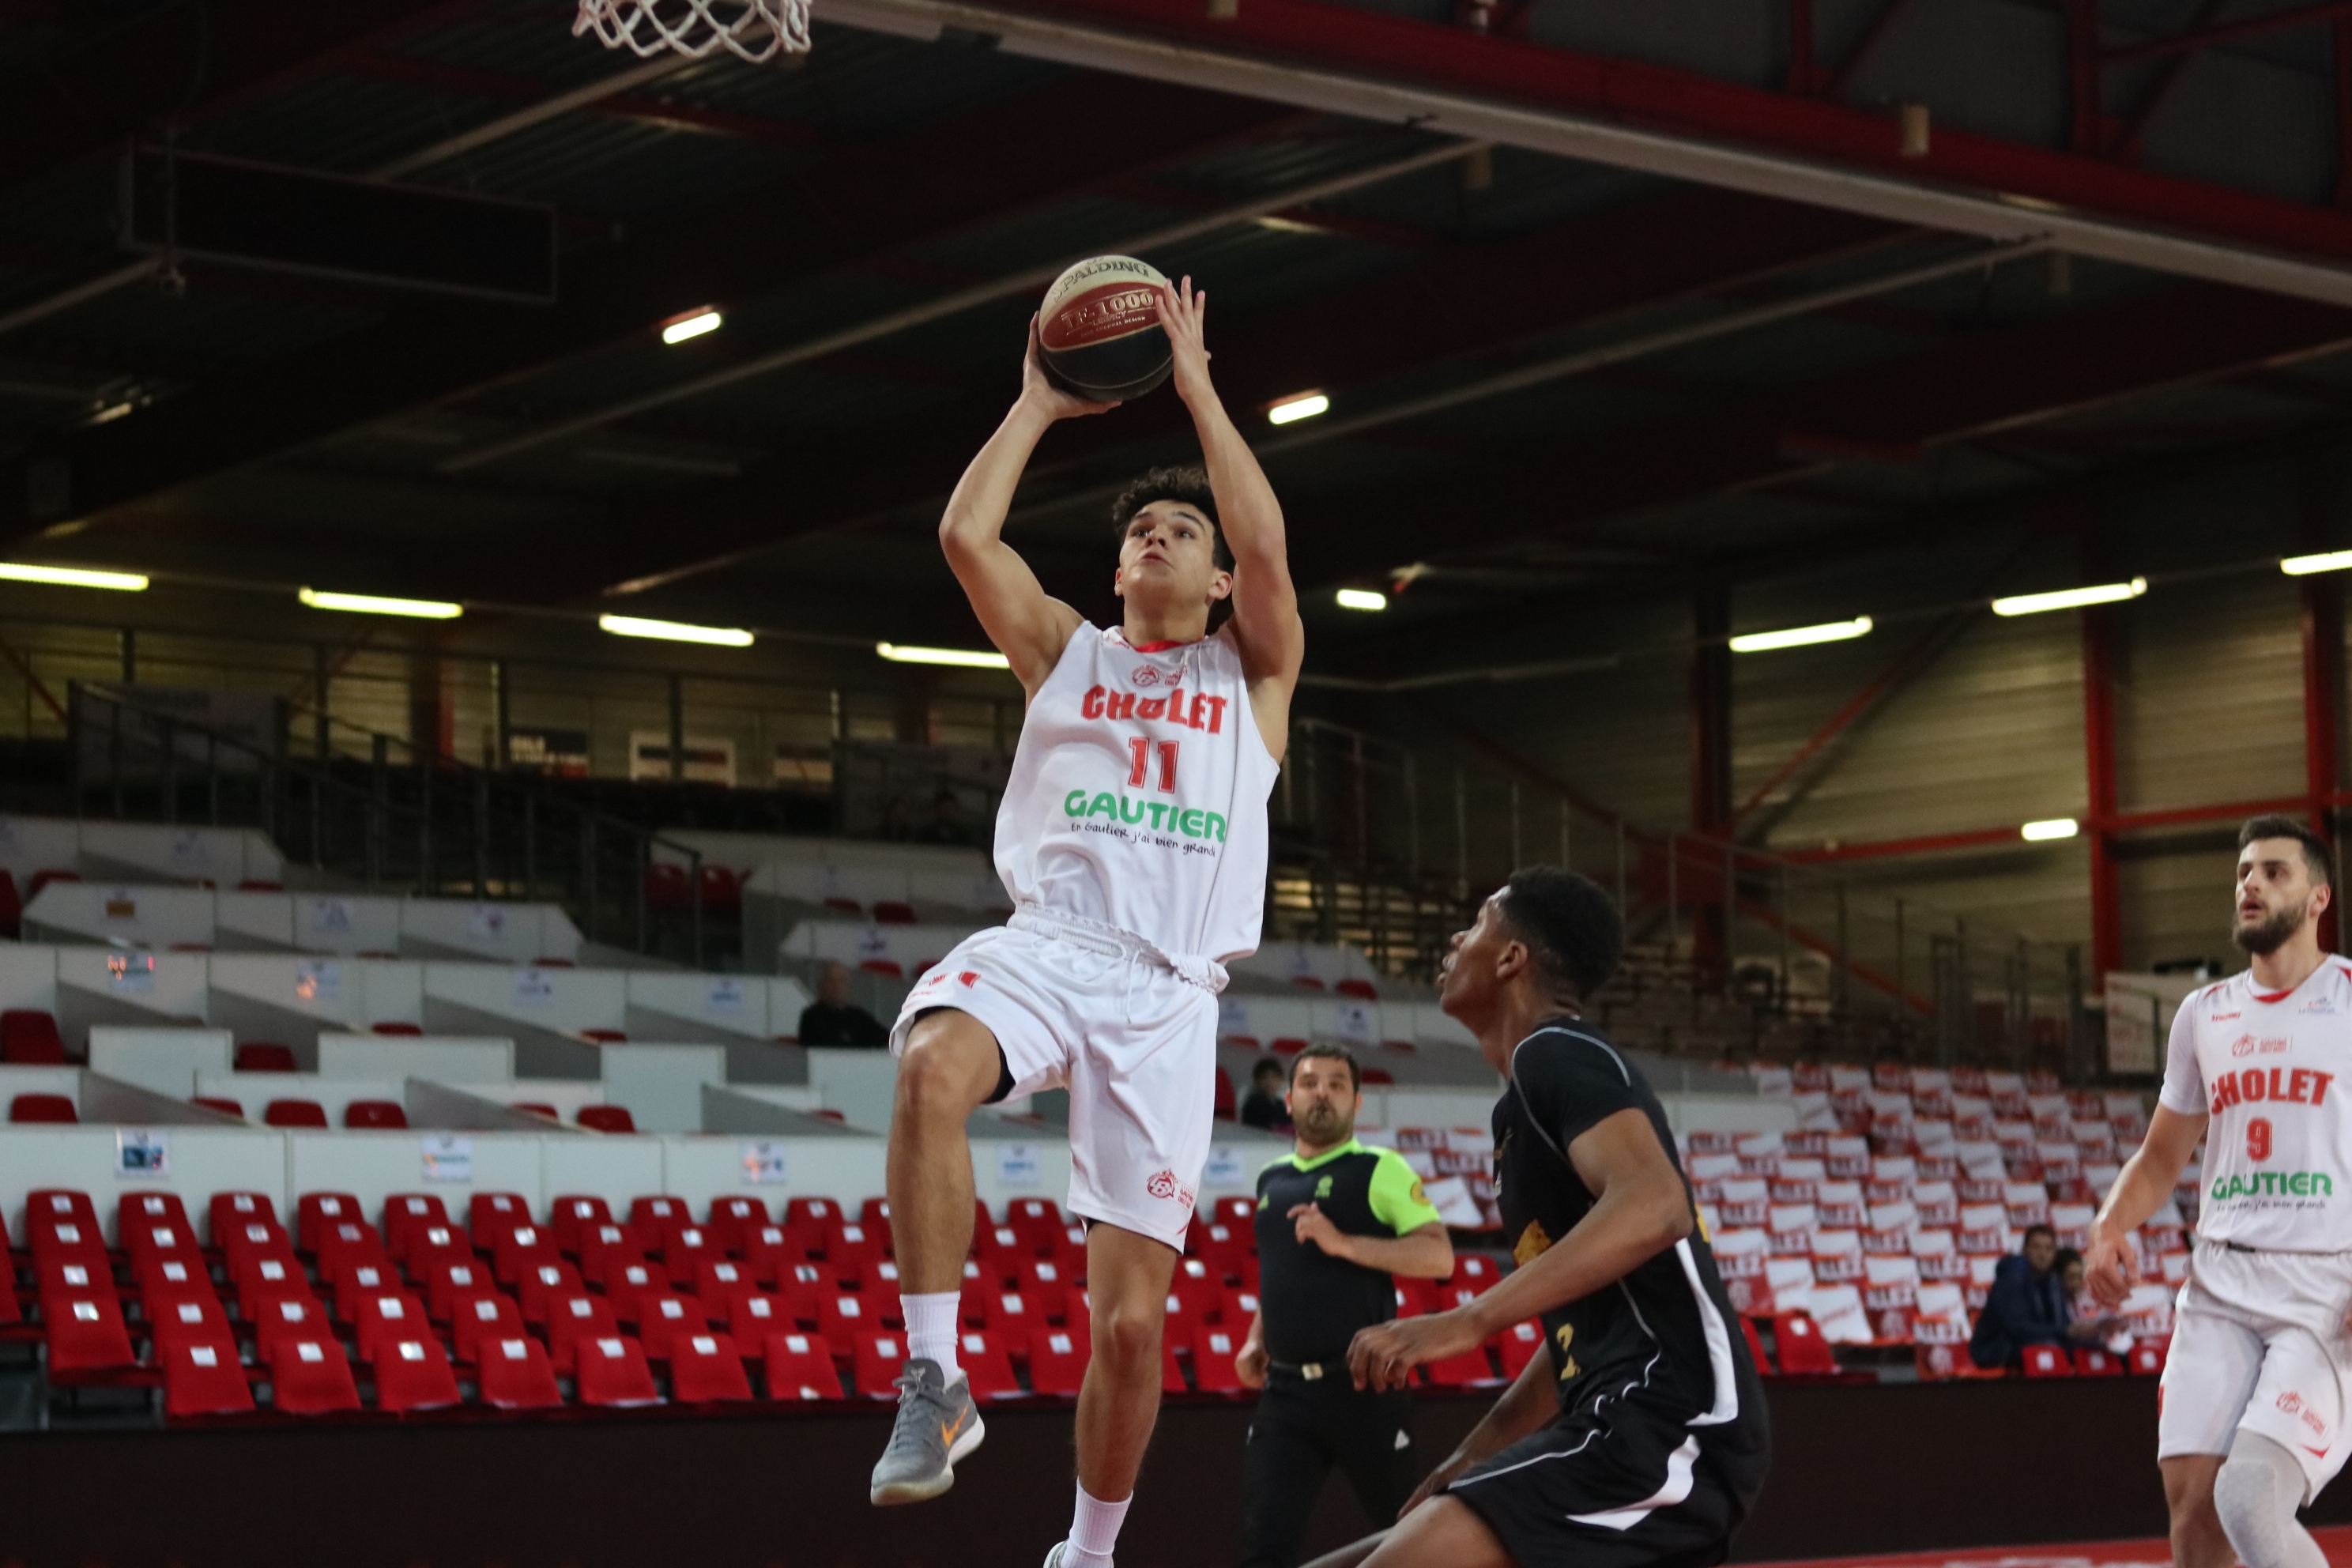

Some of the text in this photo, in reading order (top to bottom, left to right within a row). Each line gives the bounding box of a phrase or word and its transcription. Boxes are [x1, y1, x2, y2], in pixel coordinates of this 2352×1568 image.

[1051, 261, 1150, 303] SPALDING
[1081, 684, 1228, 735] CHOLET
[1128, 736, 1180, 794] 11
[1064, 790, 1226, 842] GAUTIER
[1131, 831, 1150, 844] j'ai
[1155, 836, 1178, 849] bien
[2247, 1117, 2273, 1163] 9
[2211, 1171, 2333, 1200] GAUTIER
